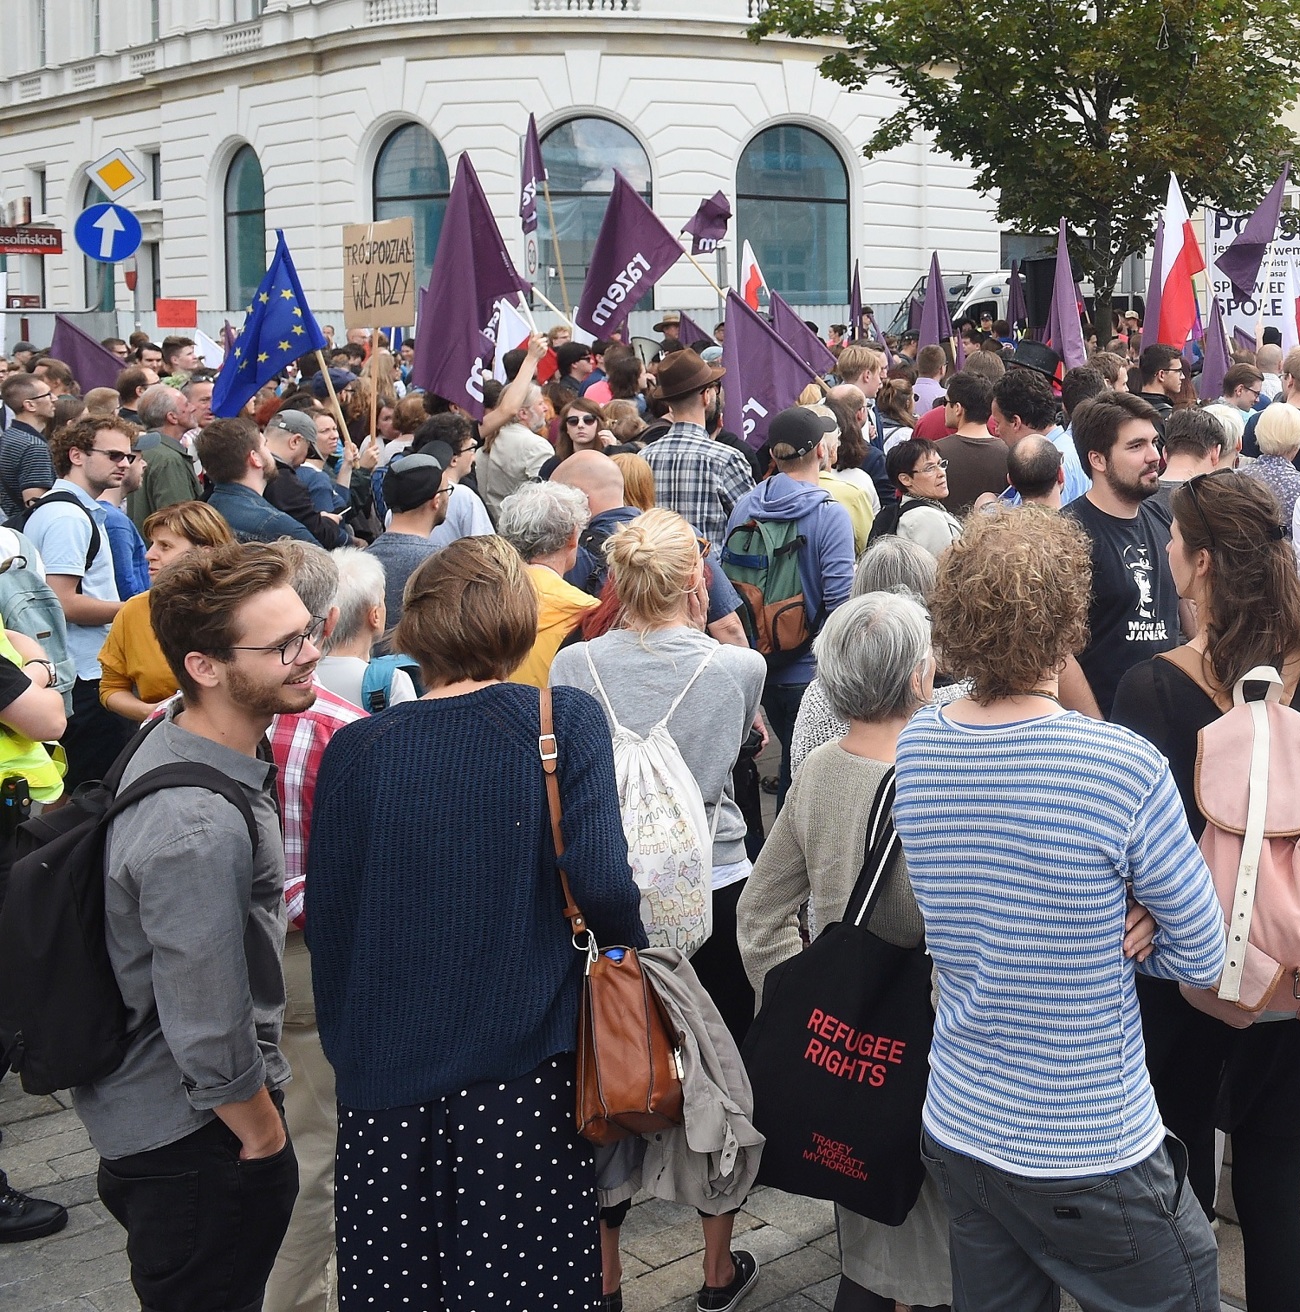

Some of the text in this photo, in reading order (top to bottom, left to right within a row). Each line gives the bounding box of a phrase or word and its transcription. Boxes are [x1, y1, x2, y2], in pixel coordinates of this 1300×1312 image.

[1213, 242, 1229, 255] jes
[351, 271, 410, 311] WŁADZY
[1125, 630, 1168, 641] JANEK
[806, 1008, 906, 1064] REFUGEE
[804, 1037, 887, 1087] RIGHTS
[811, 1132, 853, 1155] TRACEY
[816, 1145, 865, 1170] MOFFATT
[802, 1149, 868, 1181] MY HORIZON
